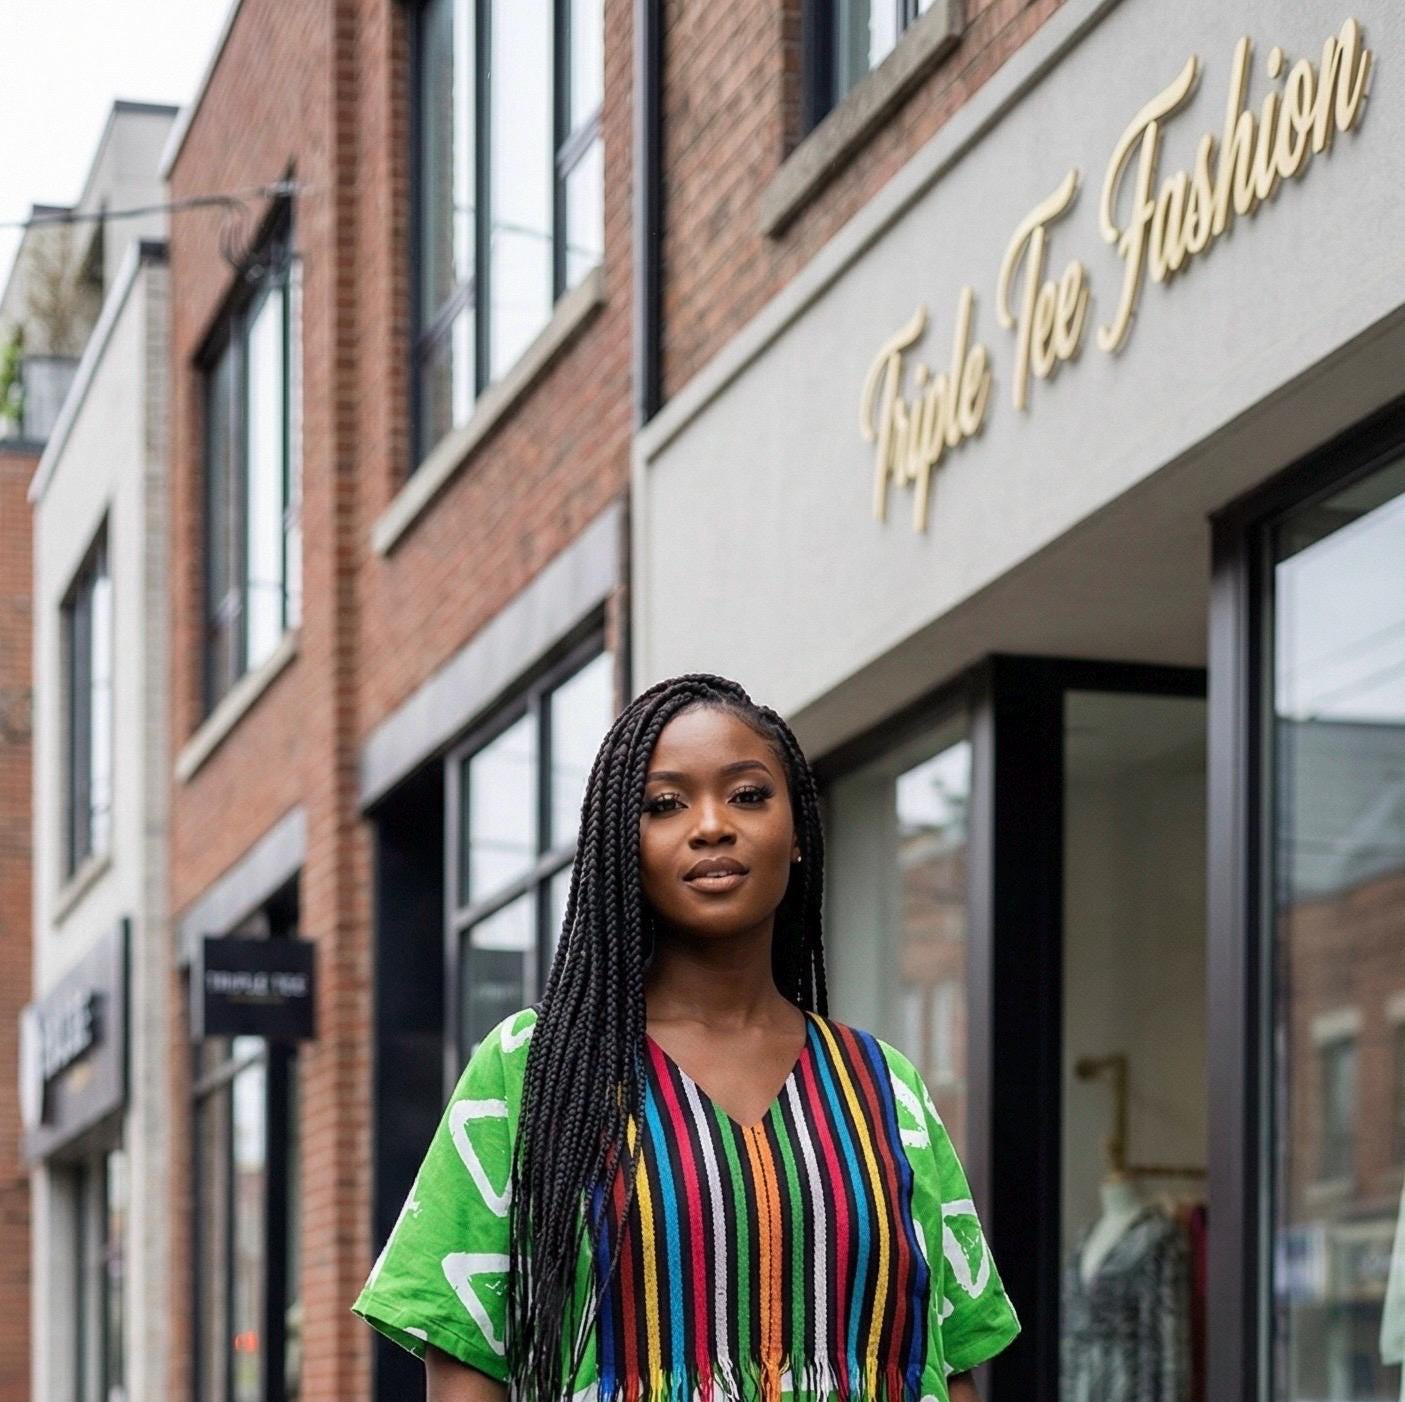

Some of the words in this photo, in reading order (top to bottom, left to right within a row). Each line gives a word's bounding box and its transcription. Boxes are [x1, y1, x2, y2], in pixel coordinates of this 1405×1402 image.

[860, 286, 990, 533] Triple
[998, 168, 1087, 410] Tee
[1098, 16, 1371, 353] Fashion
